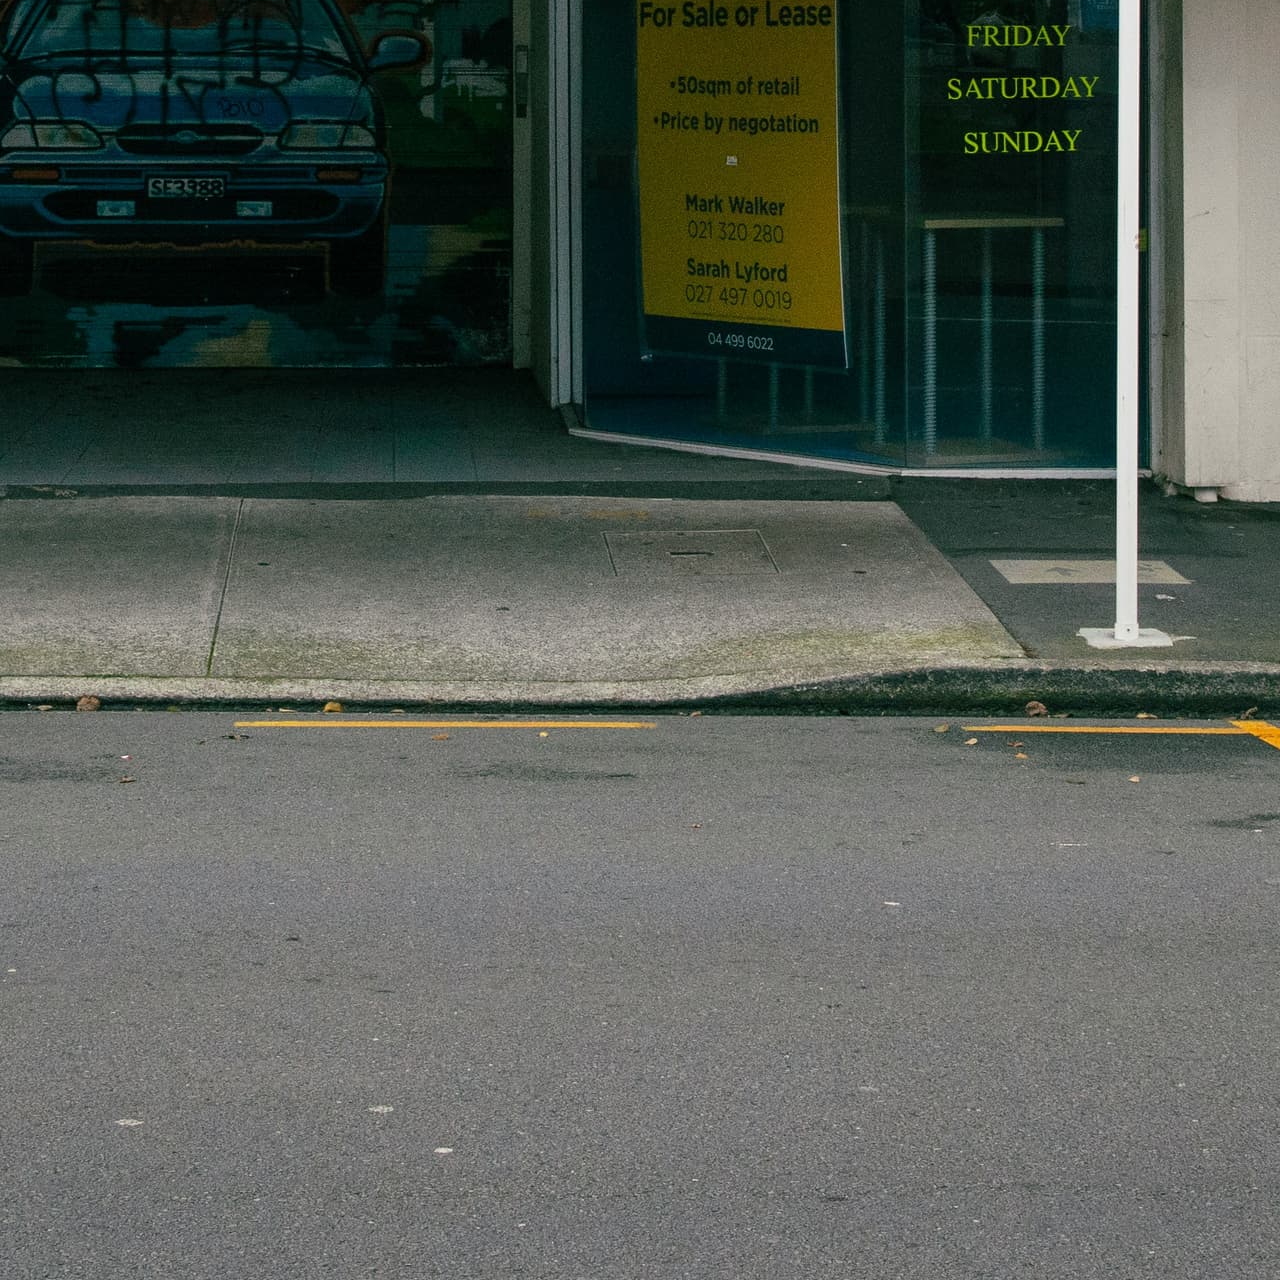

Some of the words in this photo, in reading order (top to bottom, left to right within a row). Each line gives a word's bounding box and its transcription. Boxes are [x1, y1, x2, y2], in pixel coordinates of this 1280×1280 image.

[639, 1, 676, 27] For
[682, 0, 728, 27] Sale
[735, 6, 758, 26] or
[766, 0, 832, 26] Lease
[966, 25, 1071, 47] FRIDAY
[736, 76, 752, 94] of
[758, 76, 800, 95] retail
[947, 76, 1099, 100] SATURDAY
[704, 112, 721, 133] by
[729, 114, 818, 135] negotation
[963, 130, 1082, 154] SUNDAY
[685, 194, 722, 213] Mark
[728, 196, 785, 216] Walker
[687, 221, 713, 239] 021
[719, 223, 748, 241] 320
[753, 224, 784, 243] 280
[687, 258, 730, 278] Sarah
[735, 261, 787, 283] Lyford
[685, 285, 713, 303] 027
[719, 288, 747, 305] 497
[753, 289, 792, 310] 0019
[708, 333, 723, 344] 04
[724, 334, 745, 348] 499
[747, 336, 774, 350] 6022
